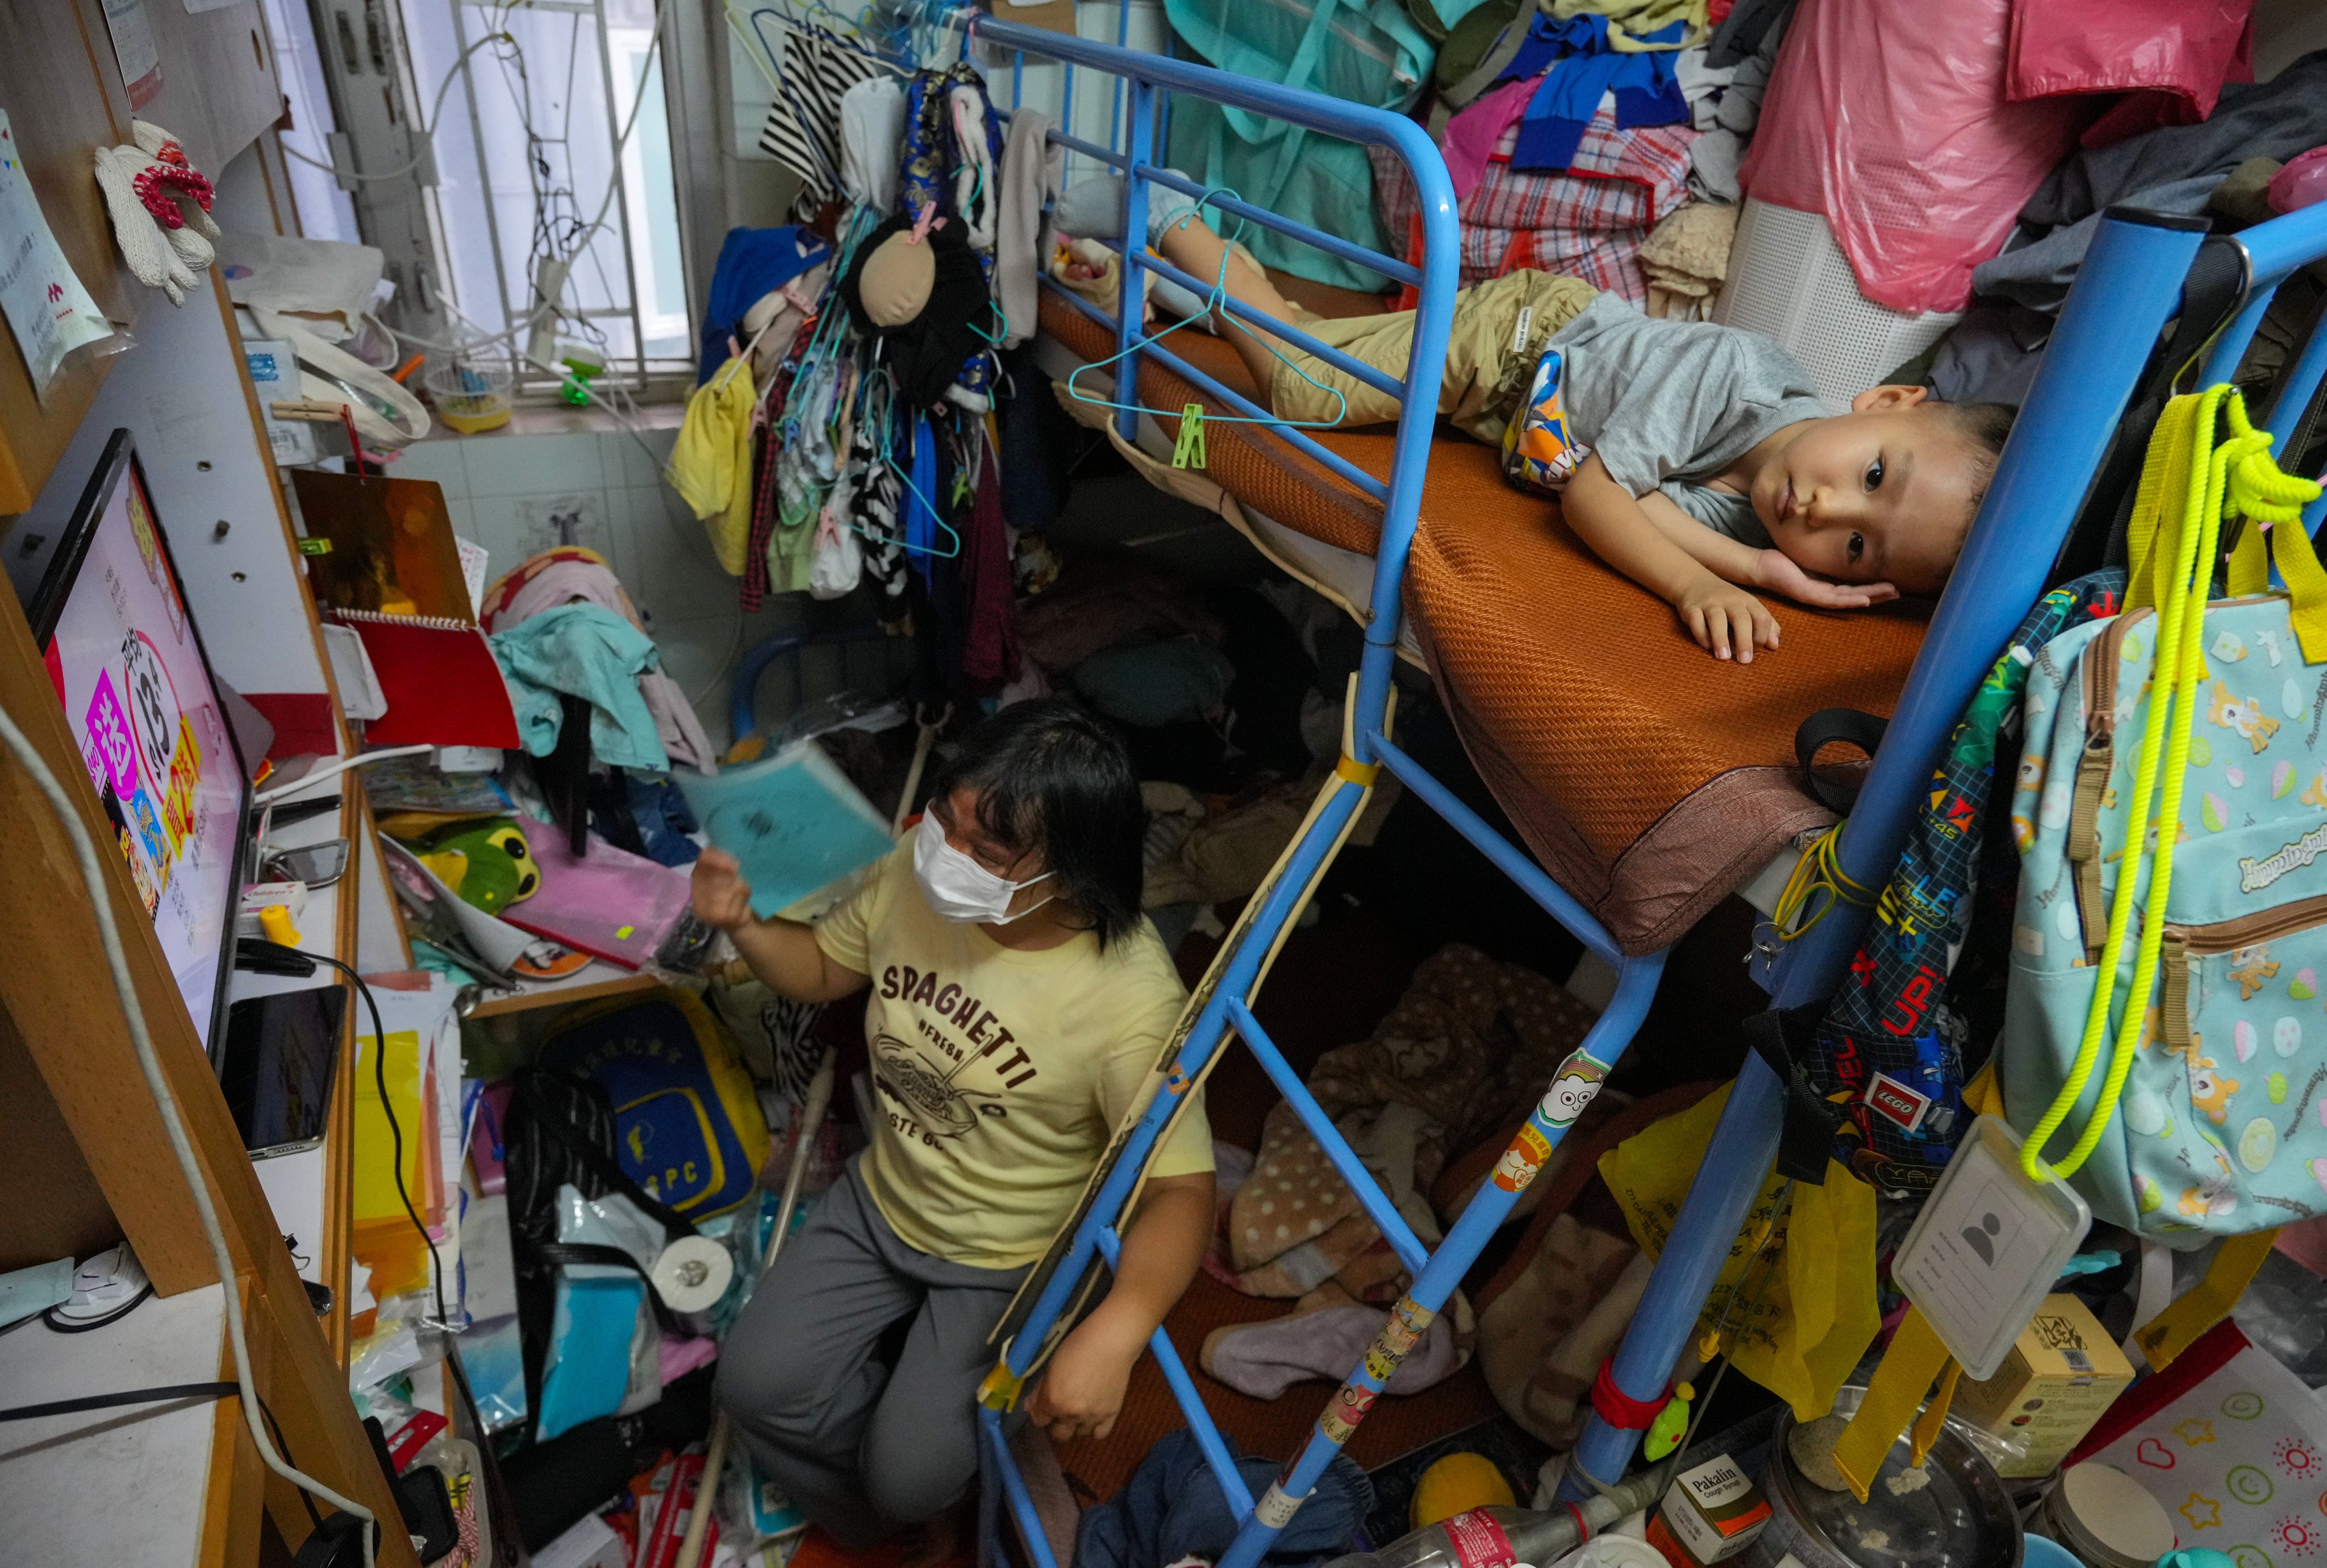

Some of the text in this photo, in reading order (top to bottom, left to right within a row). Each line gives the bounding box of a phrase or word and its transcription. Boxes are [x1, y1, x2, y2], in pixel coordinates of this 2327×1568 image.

[120, 627, 142, 677] 平均
[94, 691, 132, 789] 送
[1880, 964, 1946, 1037] UP!
[881, 965, 1037, 1090] SPAGHETTI
[1876, 1090, 1915, 1115] LEGO
[1692, 1468, 1737, 1493] Pakalin
[1704, 1479, 1741, 1499] Cough Syrup
[1477, 1511, 1494, 1528] TASTE
